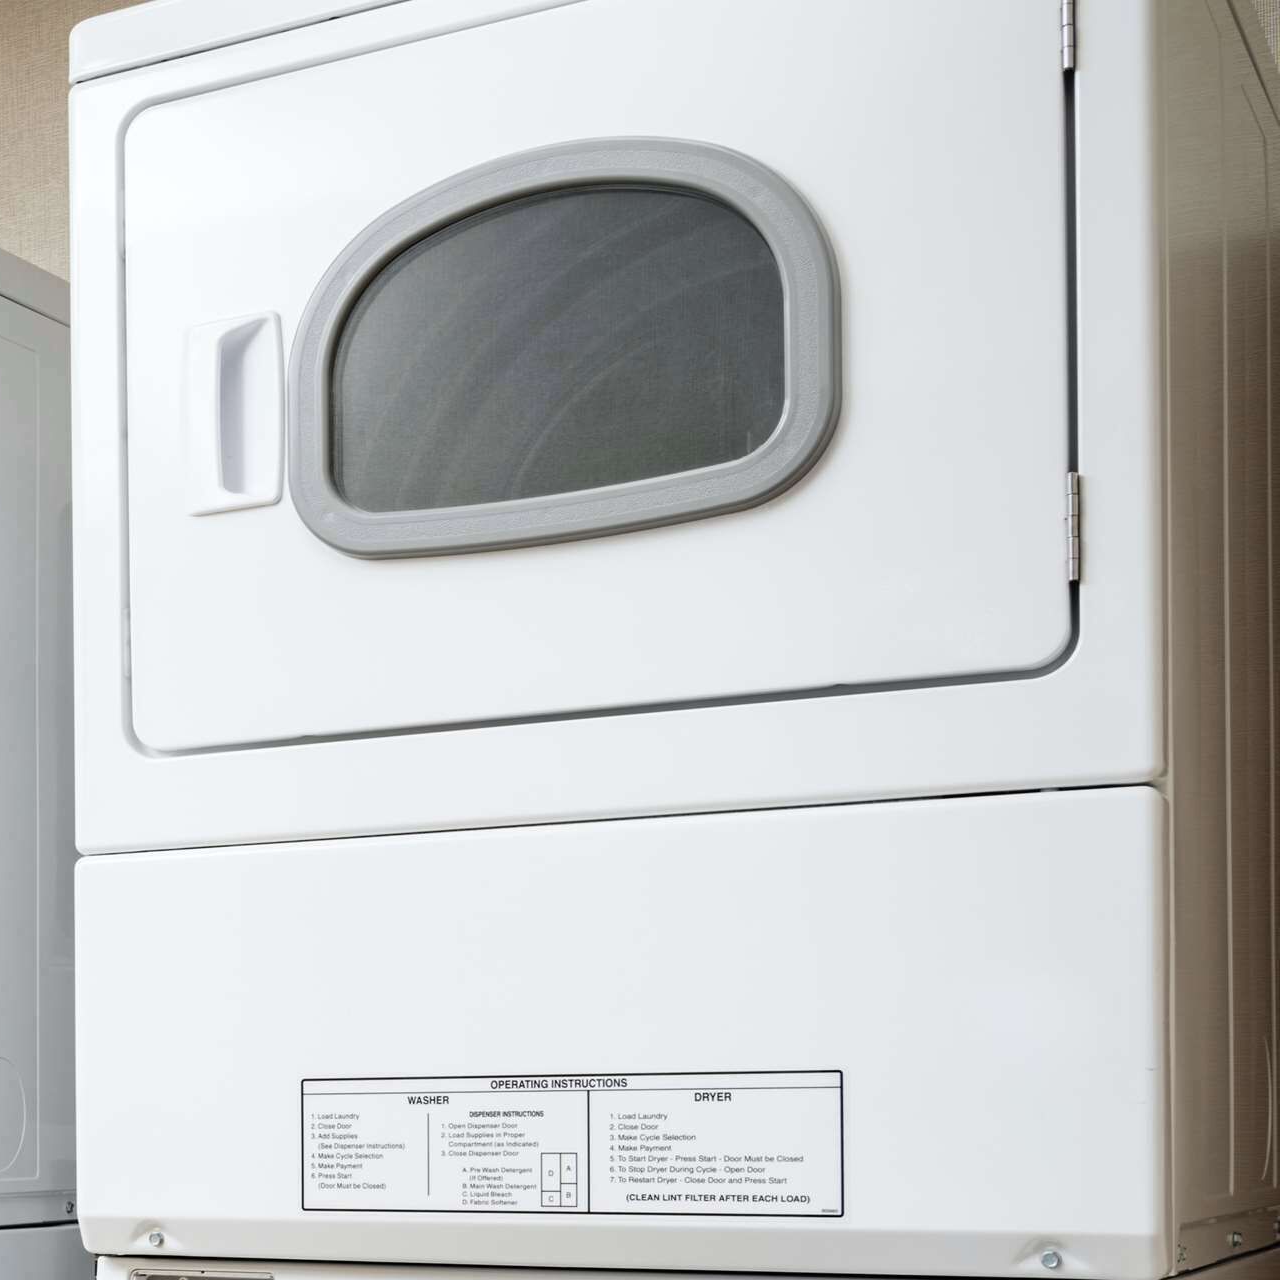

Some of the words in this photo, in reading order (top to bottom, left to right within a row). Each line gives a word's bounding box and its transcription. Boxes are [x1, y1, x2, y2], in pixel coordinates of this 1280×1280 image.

[490, 1079, 549, 1090] OPERATING
[551, 1078, 628, 1089] INSTRUCTIONS
[408, 1096, 449, 1105] WASHER
[695, 1093, 732, 1102] DRYER
[638, 1113, 668, 1121] Laundry
[640, 1145, 672, 1153] Payment
[628, 1166, 645, 1174] Stop
[648, 1166, 667, 1174] Dryer
[670, 1166, 694, 1174] During
[724, 1167, 745, 1175] Open
[657, 1177, 677, 1185] Dryer
[626, 1194, 660, 1202] (CLEAN
[685, 1194, 716, 1202] FILTER
[752, 1195, 777, 1203] EACH
[781, 1195, 811, 1204] LOAD)
